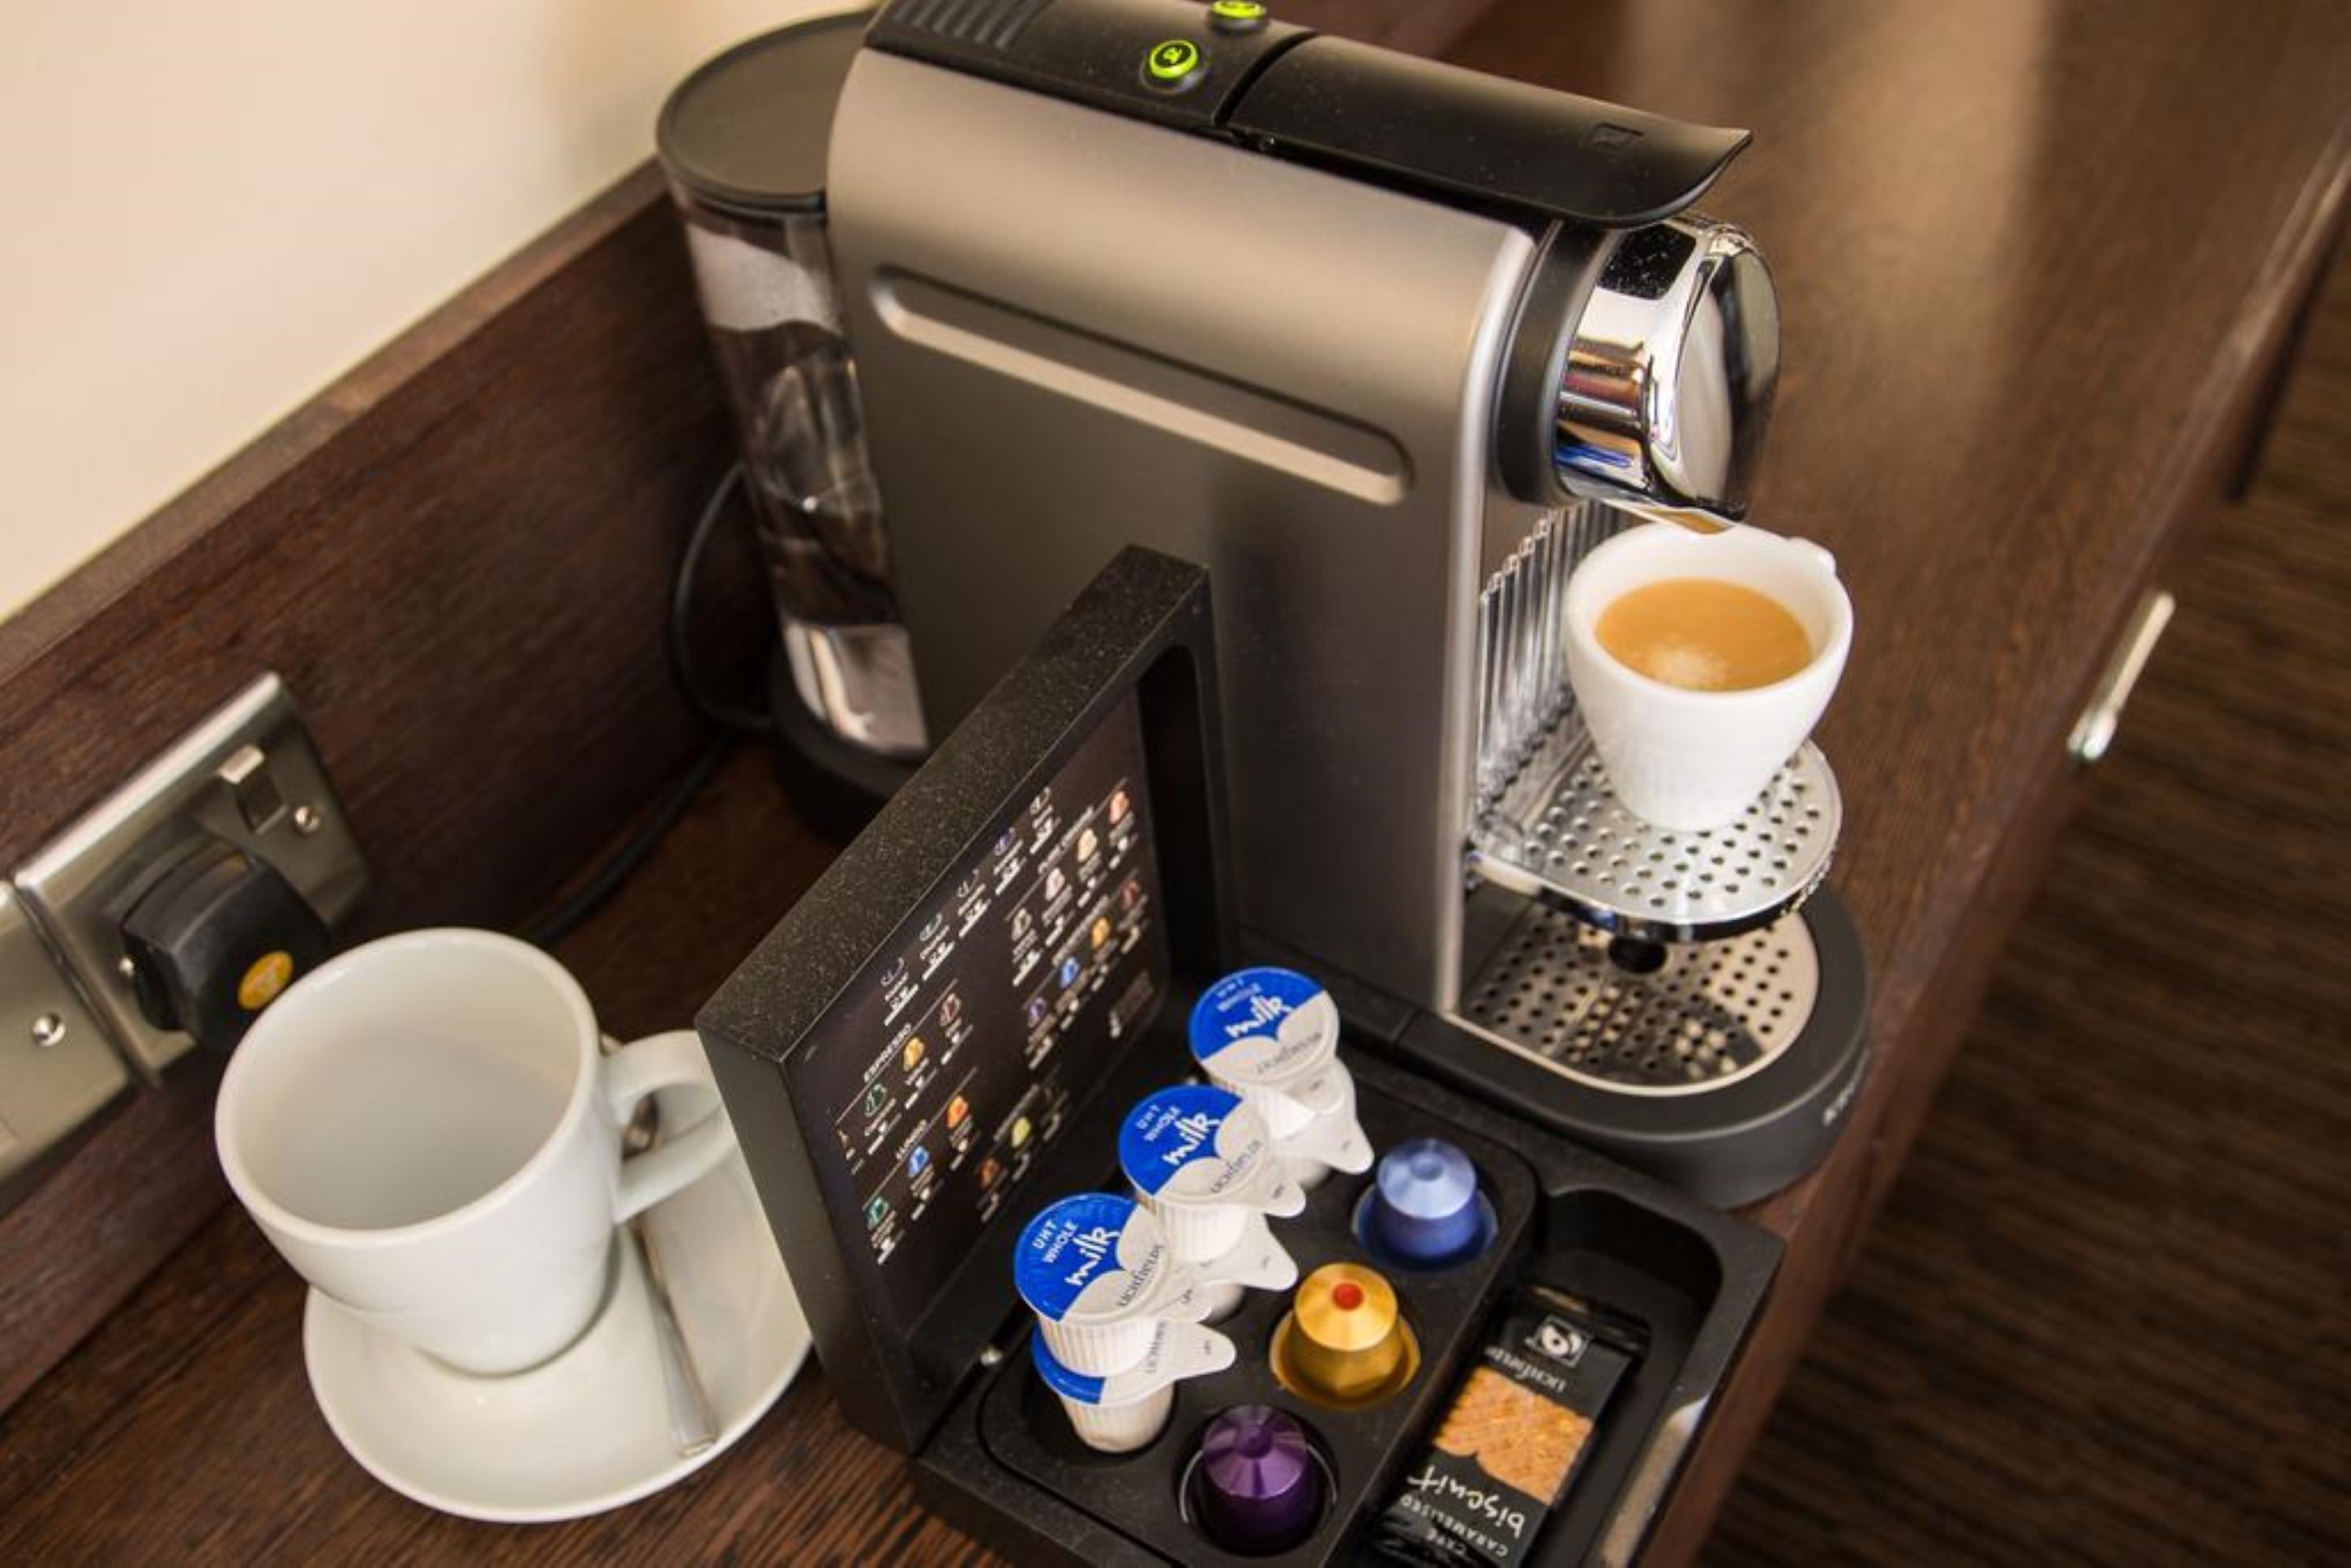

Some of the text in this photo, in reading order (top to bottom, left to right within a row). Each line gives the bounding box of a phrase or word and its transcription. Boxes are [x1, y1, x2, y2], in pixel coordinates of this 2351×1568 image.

[1224, 995, 1293, 1038] milk
[1162, 1112, 1220, 1166] milk
[1032, 1219, 1056, 1249] UHT
[1041, 1219, 1079, 1264] WHOLE
[1064, 1226, 1121, 1287] milk
[1406, 1465, 1526, 1539] biscuit
